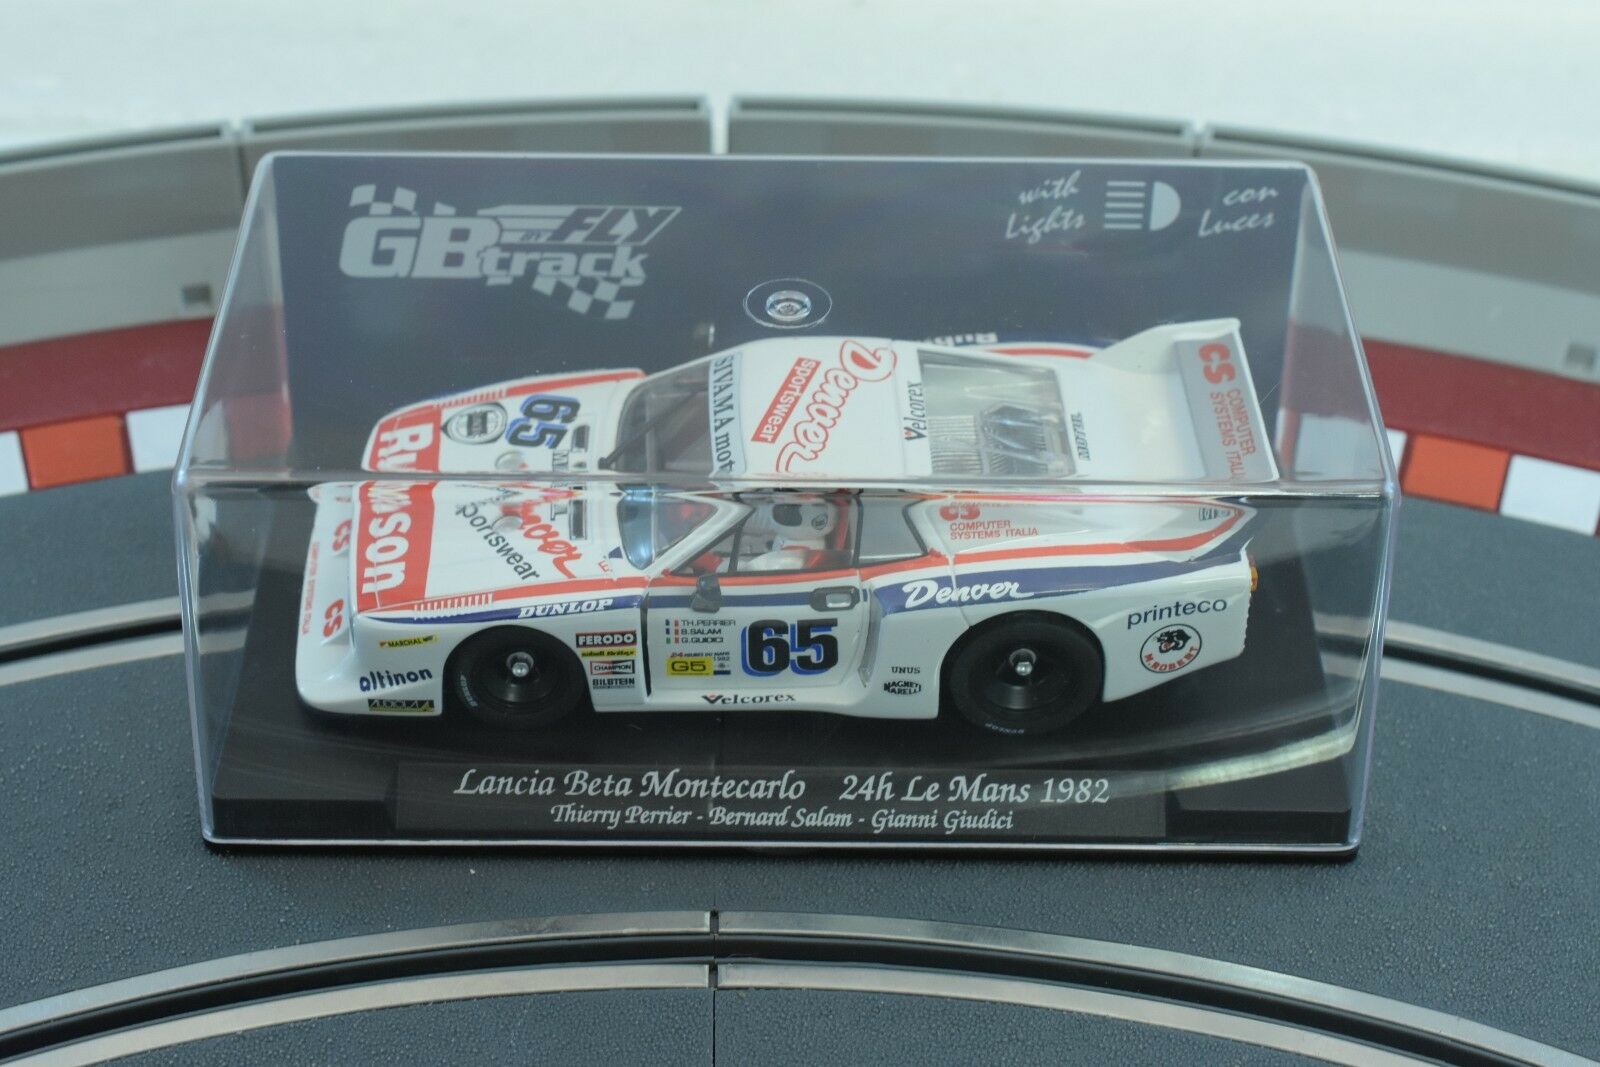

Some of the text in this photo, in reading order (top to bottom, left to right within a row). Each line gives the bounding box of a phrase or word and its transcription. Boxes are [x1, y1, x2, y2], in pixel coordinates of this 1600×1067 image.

[1018, 170, 1081, 204] with
[1223, 186, 1279, 206] con
[555, 206, 680, 245] FLY
[1005, 206, 1085, 244] Lights
[1198, 209, 1275, 237] Luces
[1198, 341, 1237, 385] CS
[758, 357, 817, 443] sportswear
[903, 380, 928, 441] Velcorex
[505, 394, 581, 450] 65
[1210, 391, 1237, 447] SYSTEMS
[1225, 388, 1257, 458] COMPUTER
[949, 520, 1012, 532] COMPUTER
[949, 527, 1039, 541] SYSTEMS ITALIA
[518, 598, 614, 619] DUNLOP
[902, 579, 1035, 609] Denver
[323, 598, 345, 638] CS
[1127, 598, 1228, 630] printeco
[578, 633, 634, 646] FERODO
[740, 617, 839, 678] 65
[358, 668, 433, 692] altinon
[671, 660, 707, 673] G5
[891, 666, 921, 674] UNUS
[701, 693, 796, 705] Velcorex
[453, 768, 1110, 804] Lancia Beta Montecarlo 24h Le Mans 1982
[550, 802, 620, 829] Thierry
[624, 804, 692, 826] Perrier
[709, 805, 790, 828] Bernard
[791, 805, 853, 828] Salam
[870, 808, 938, 834] Gianni
[943, 809, 1014, 835] Giudici
